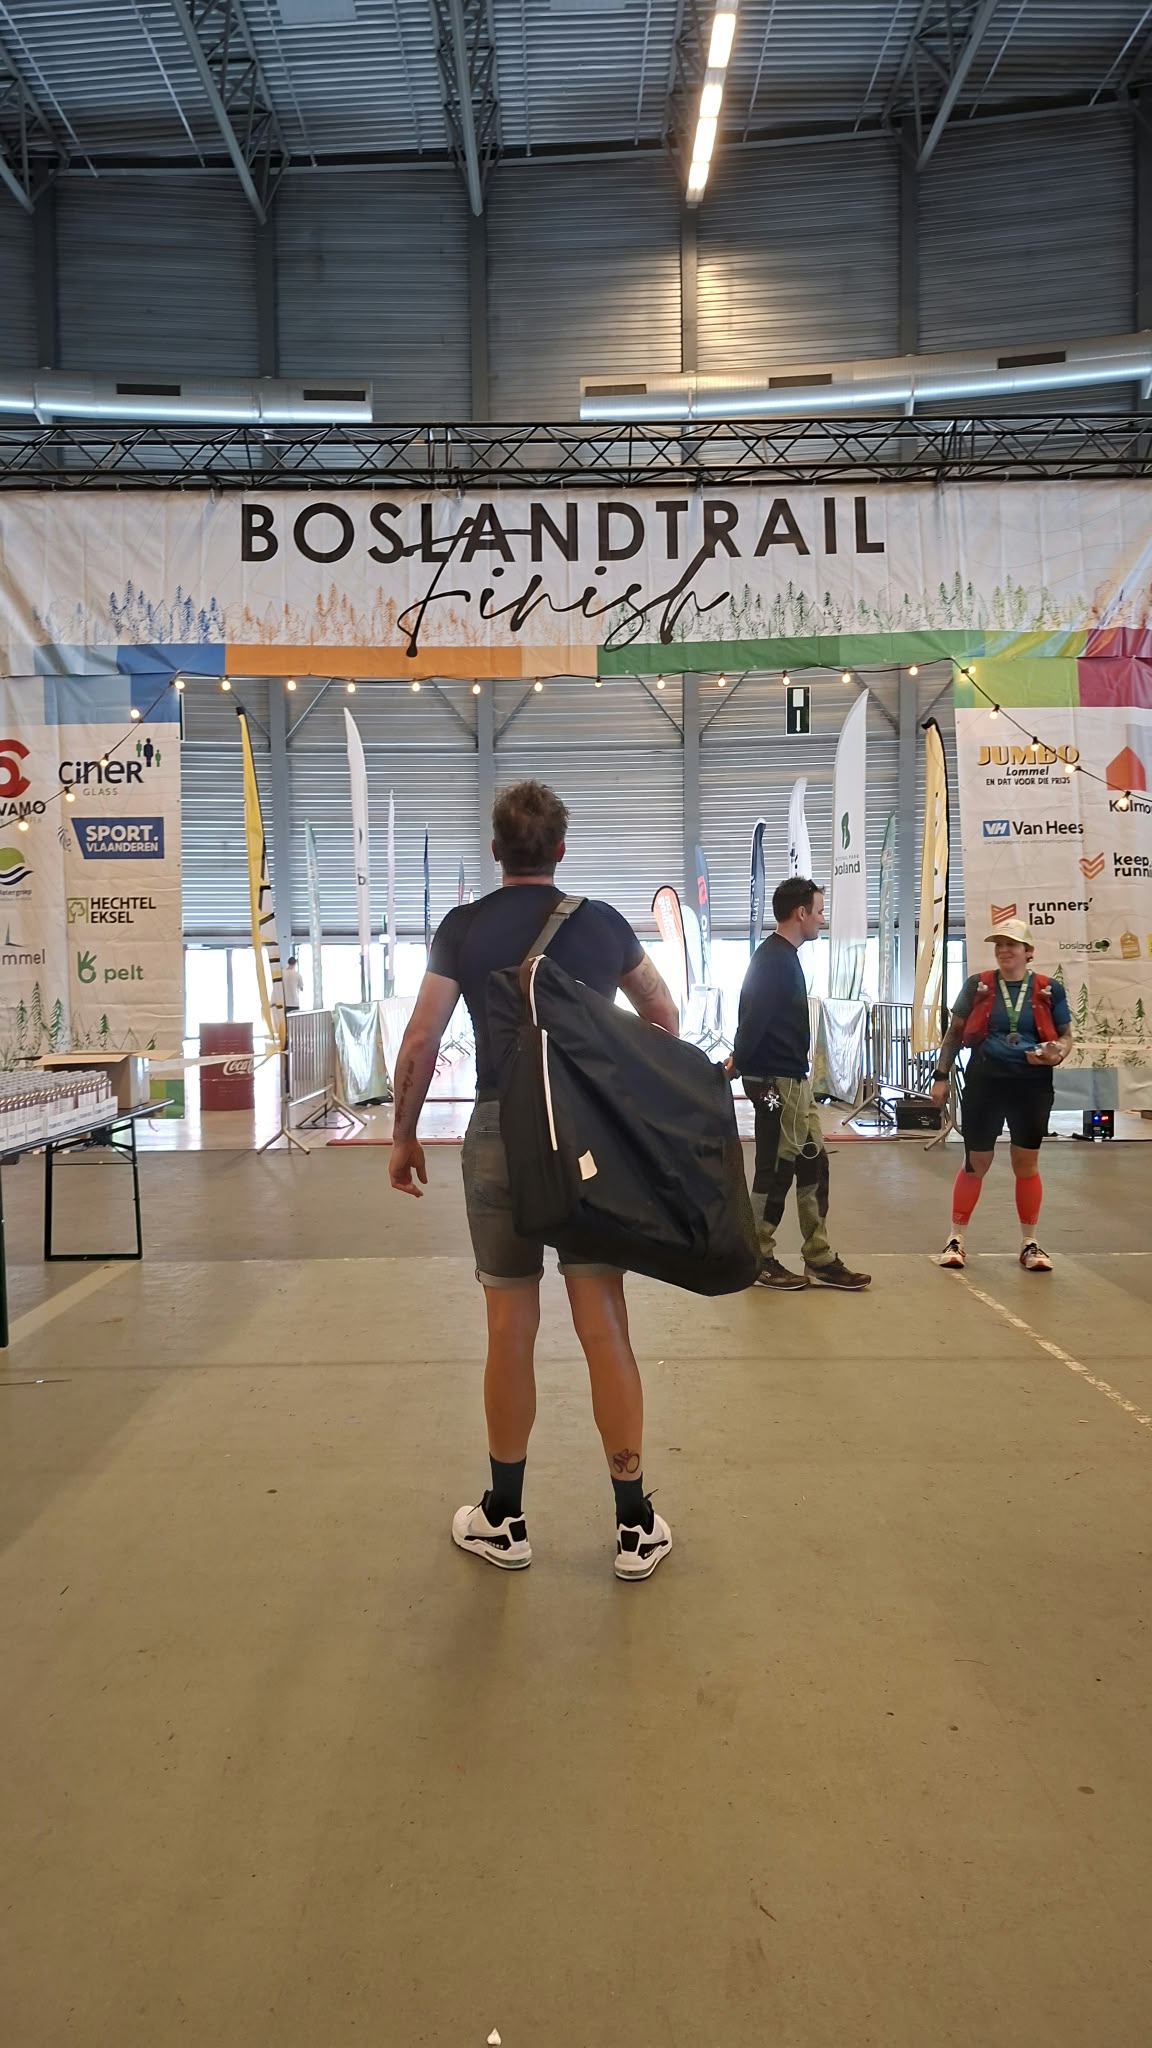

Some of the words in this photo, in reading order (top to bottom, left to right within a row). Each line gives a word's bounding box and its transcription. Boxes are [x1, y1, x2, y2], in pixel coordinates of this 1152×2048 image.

[241, 496, 885, 564] BOSLANDTRAIL
[977, 744, 1080, 766] JUMBO
[1005, 766, 1050, 777] Lommel
[986, 778, 995, 786] EN
[998, 778, 1011, 786] DAT
[1014, 777, 1036, 786] VOOR
[1038, 777, 1050, 785] DIE
[83, 788, 119, 796] GLASS
[86, 825, 159, 842] SPORT.
[984, 822, 1008, 835] VH
[1012, 821, 1043, 836] Van
[1046, 820, 1084, 835] Hees
[86, 842, 158, 852] VLAANDEREN
[90, 897, 156, 910] HECHTEL
[1028, 898, 1093, 912] runners'
[90, 911, 134, 924] EKSEL
[1029, 913, 1055, 926] lab
[104, 964, 145, 983] pelt
